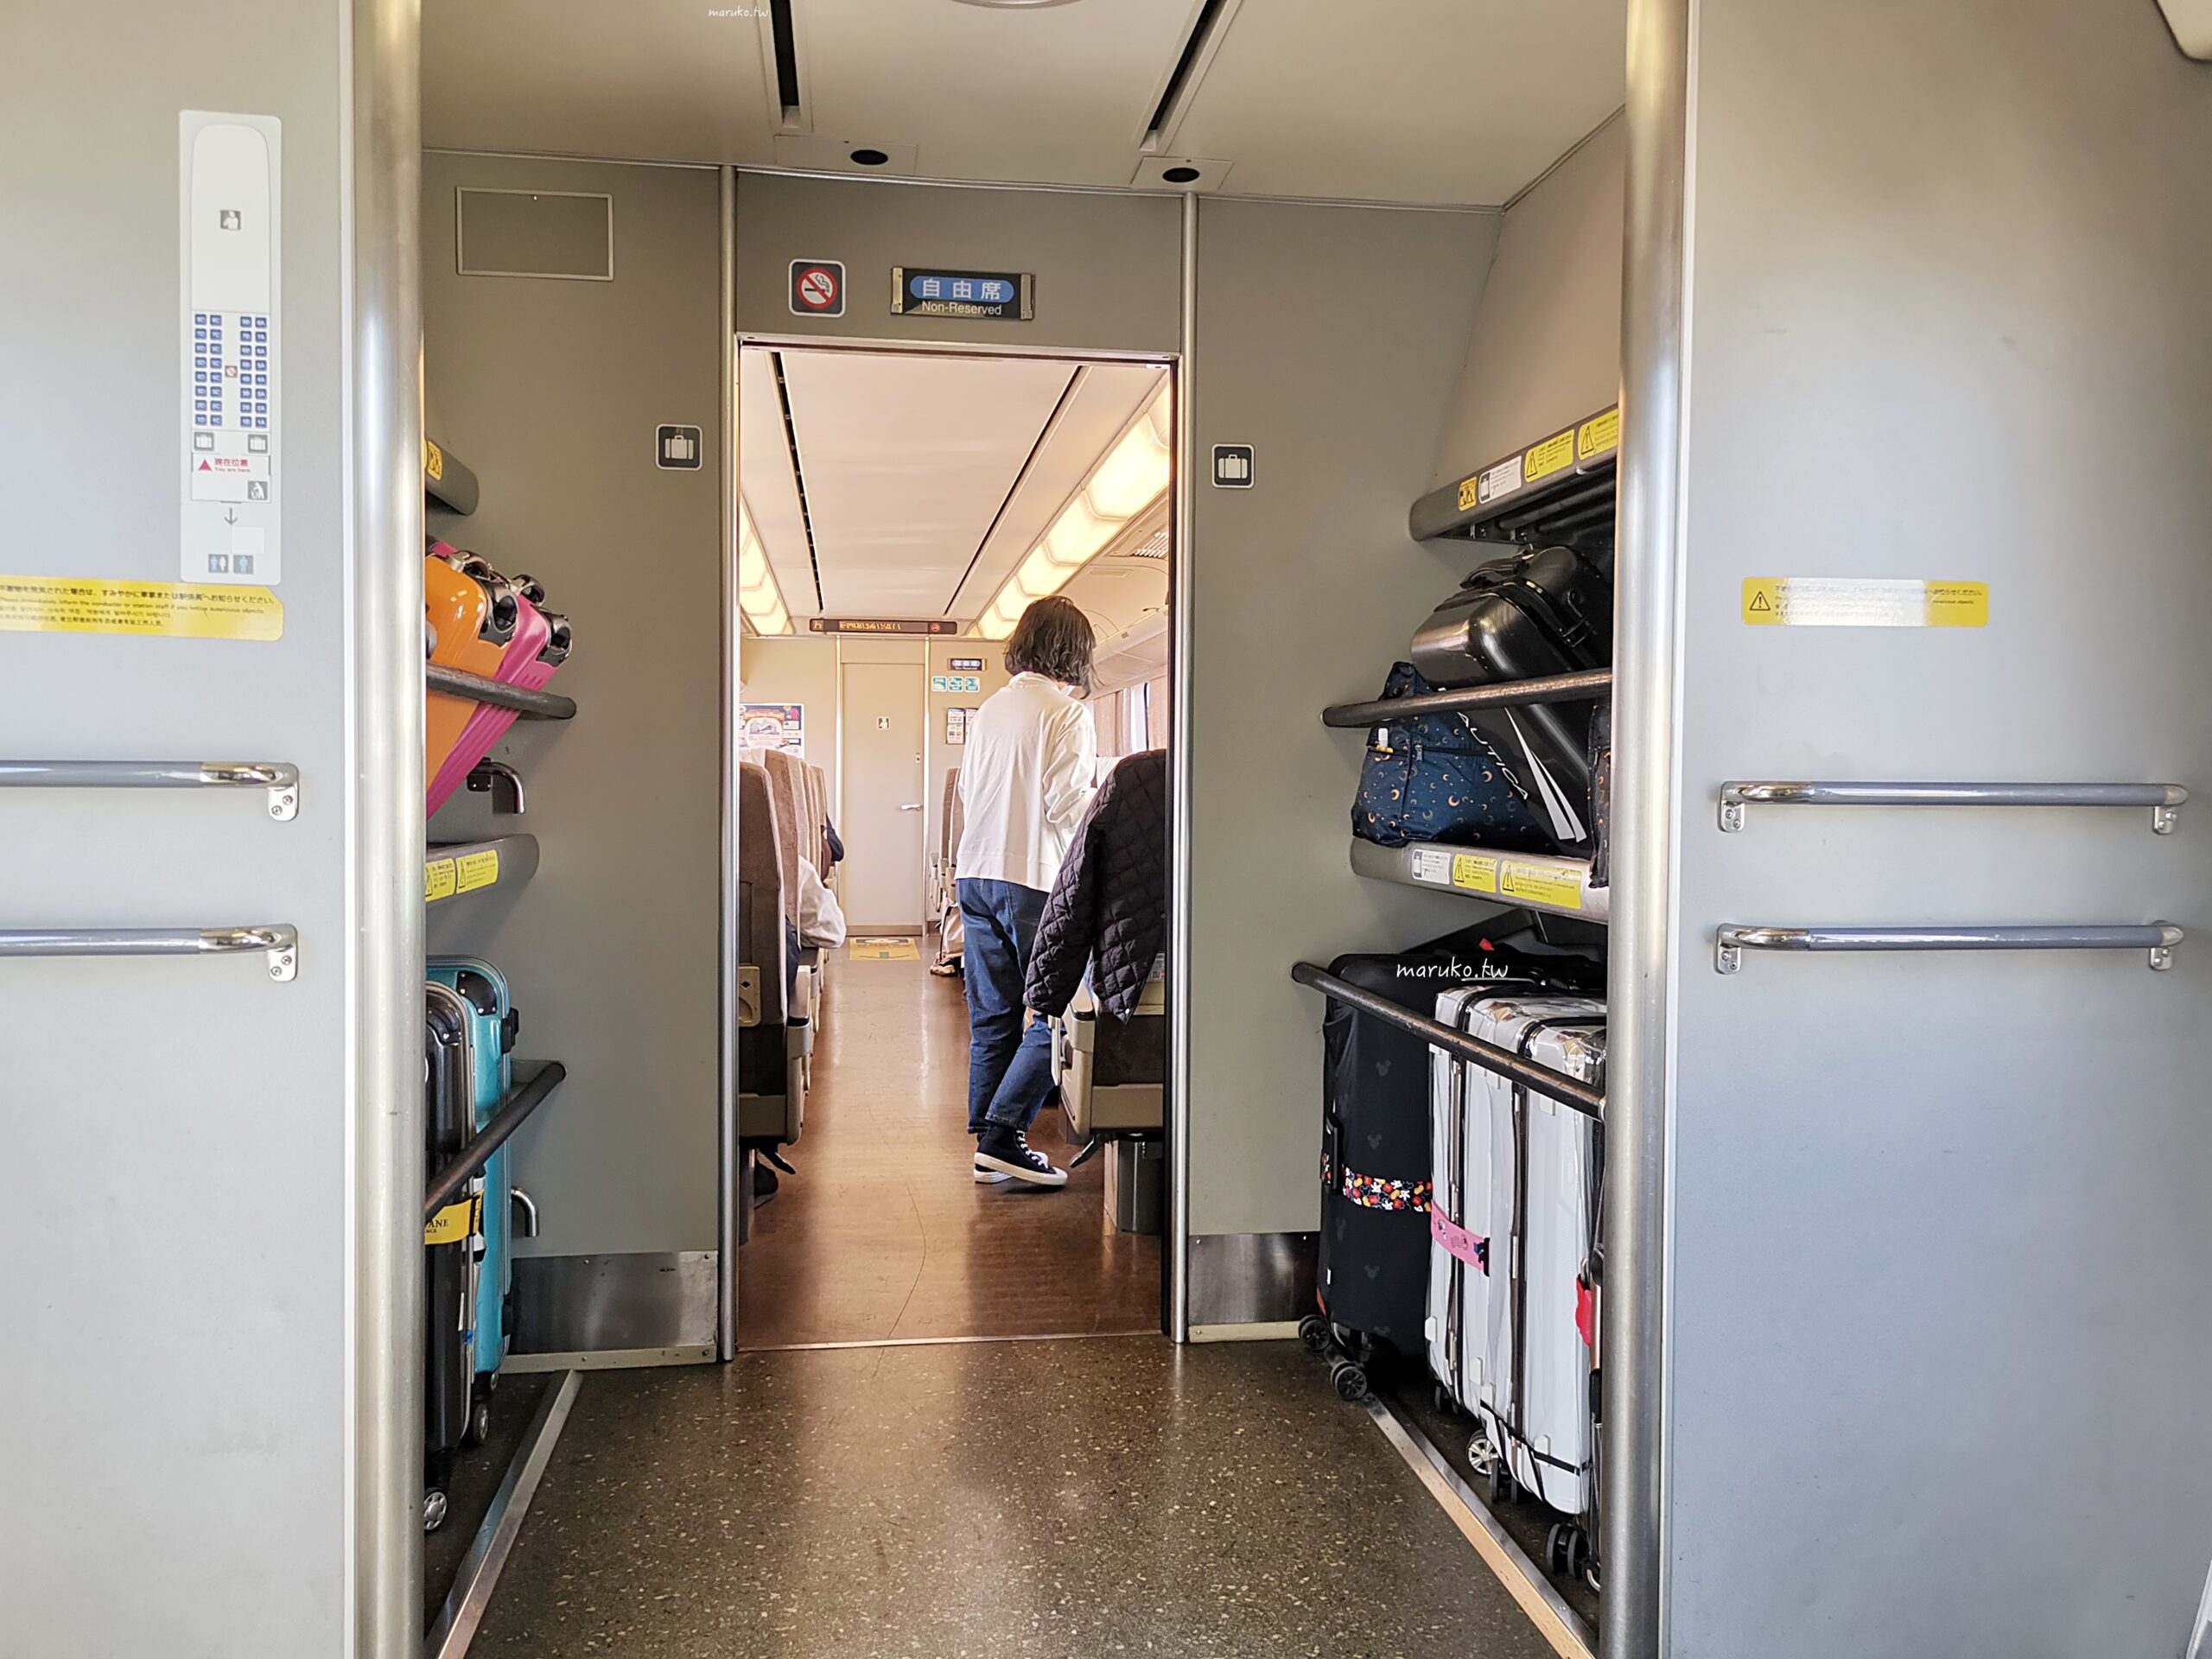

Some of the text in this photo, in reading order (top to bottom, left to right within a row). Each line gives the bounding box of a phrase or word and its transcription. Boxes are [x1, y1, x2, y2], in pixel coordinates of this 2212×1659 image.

[923, 279, 1001, 300] 自由席
[922, 301, 1001, 315] Non-Reserved
[1438, 688, 1529, 800] AUTICA
